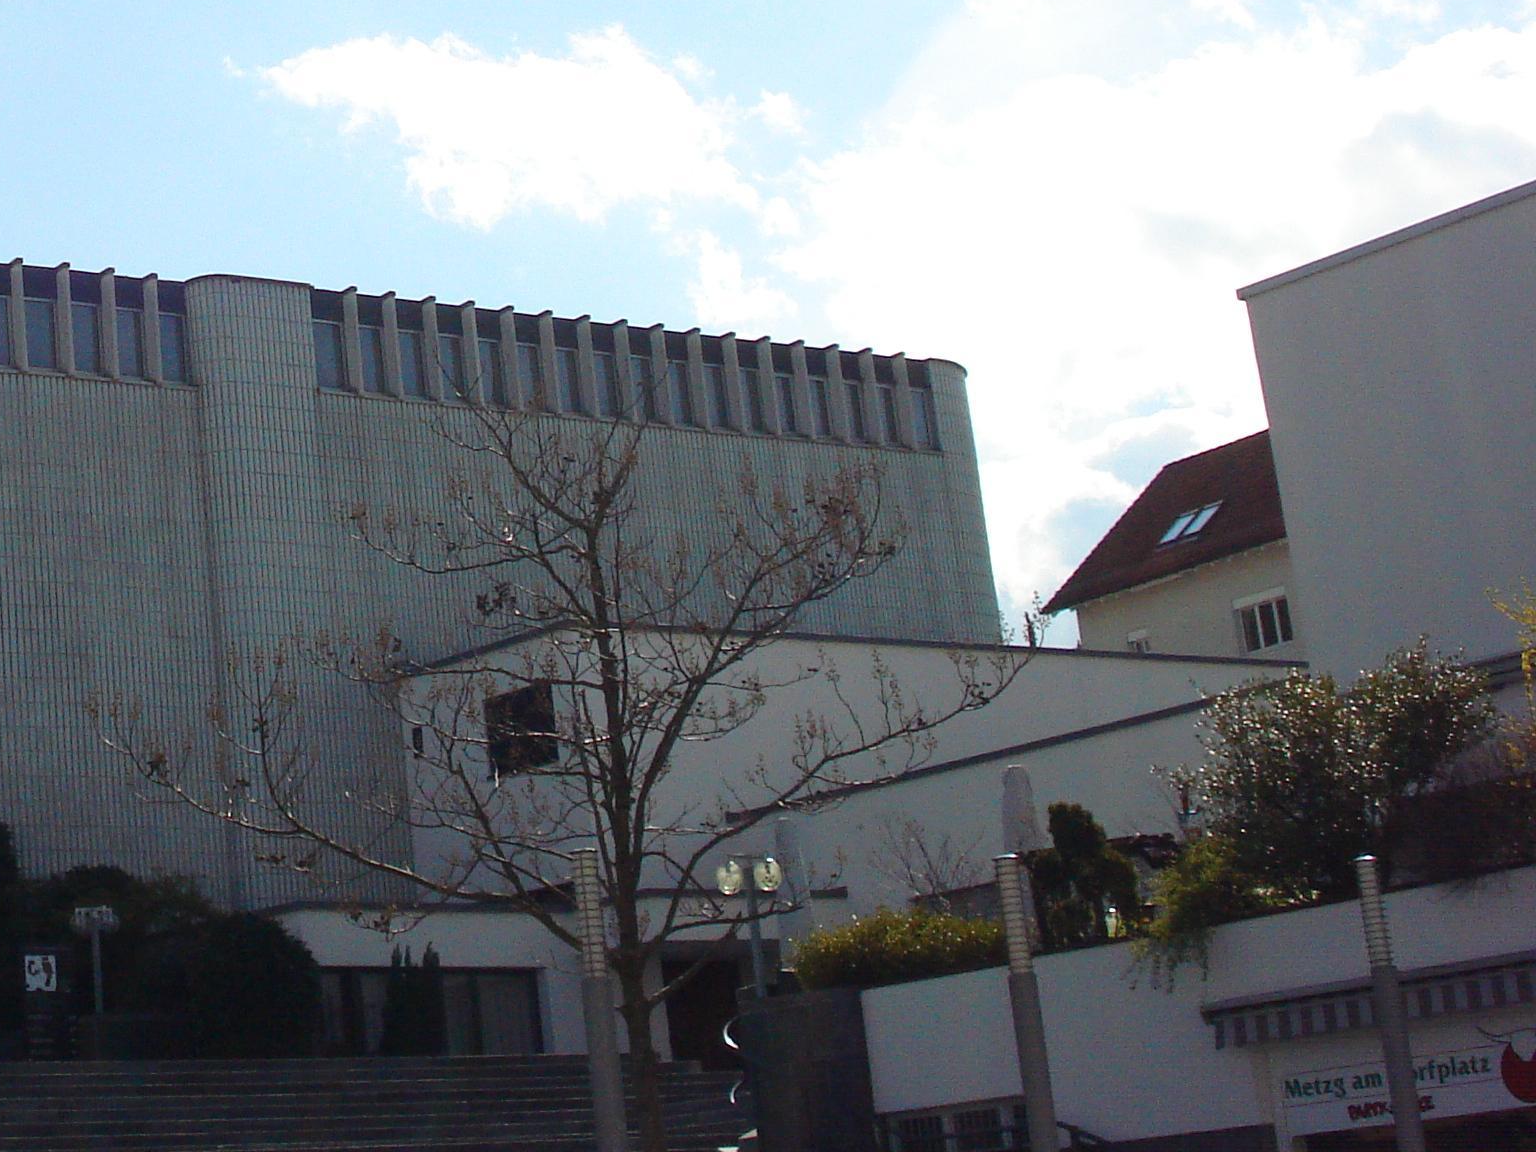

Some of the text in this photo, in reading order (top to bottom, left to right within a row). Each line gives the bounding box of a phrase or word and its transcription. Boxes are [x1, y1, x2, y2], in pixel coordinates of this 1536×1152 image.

[1283, 1055, 1491, 1099] Metzg am orfplatz
